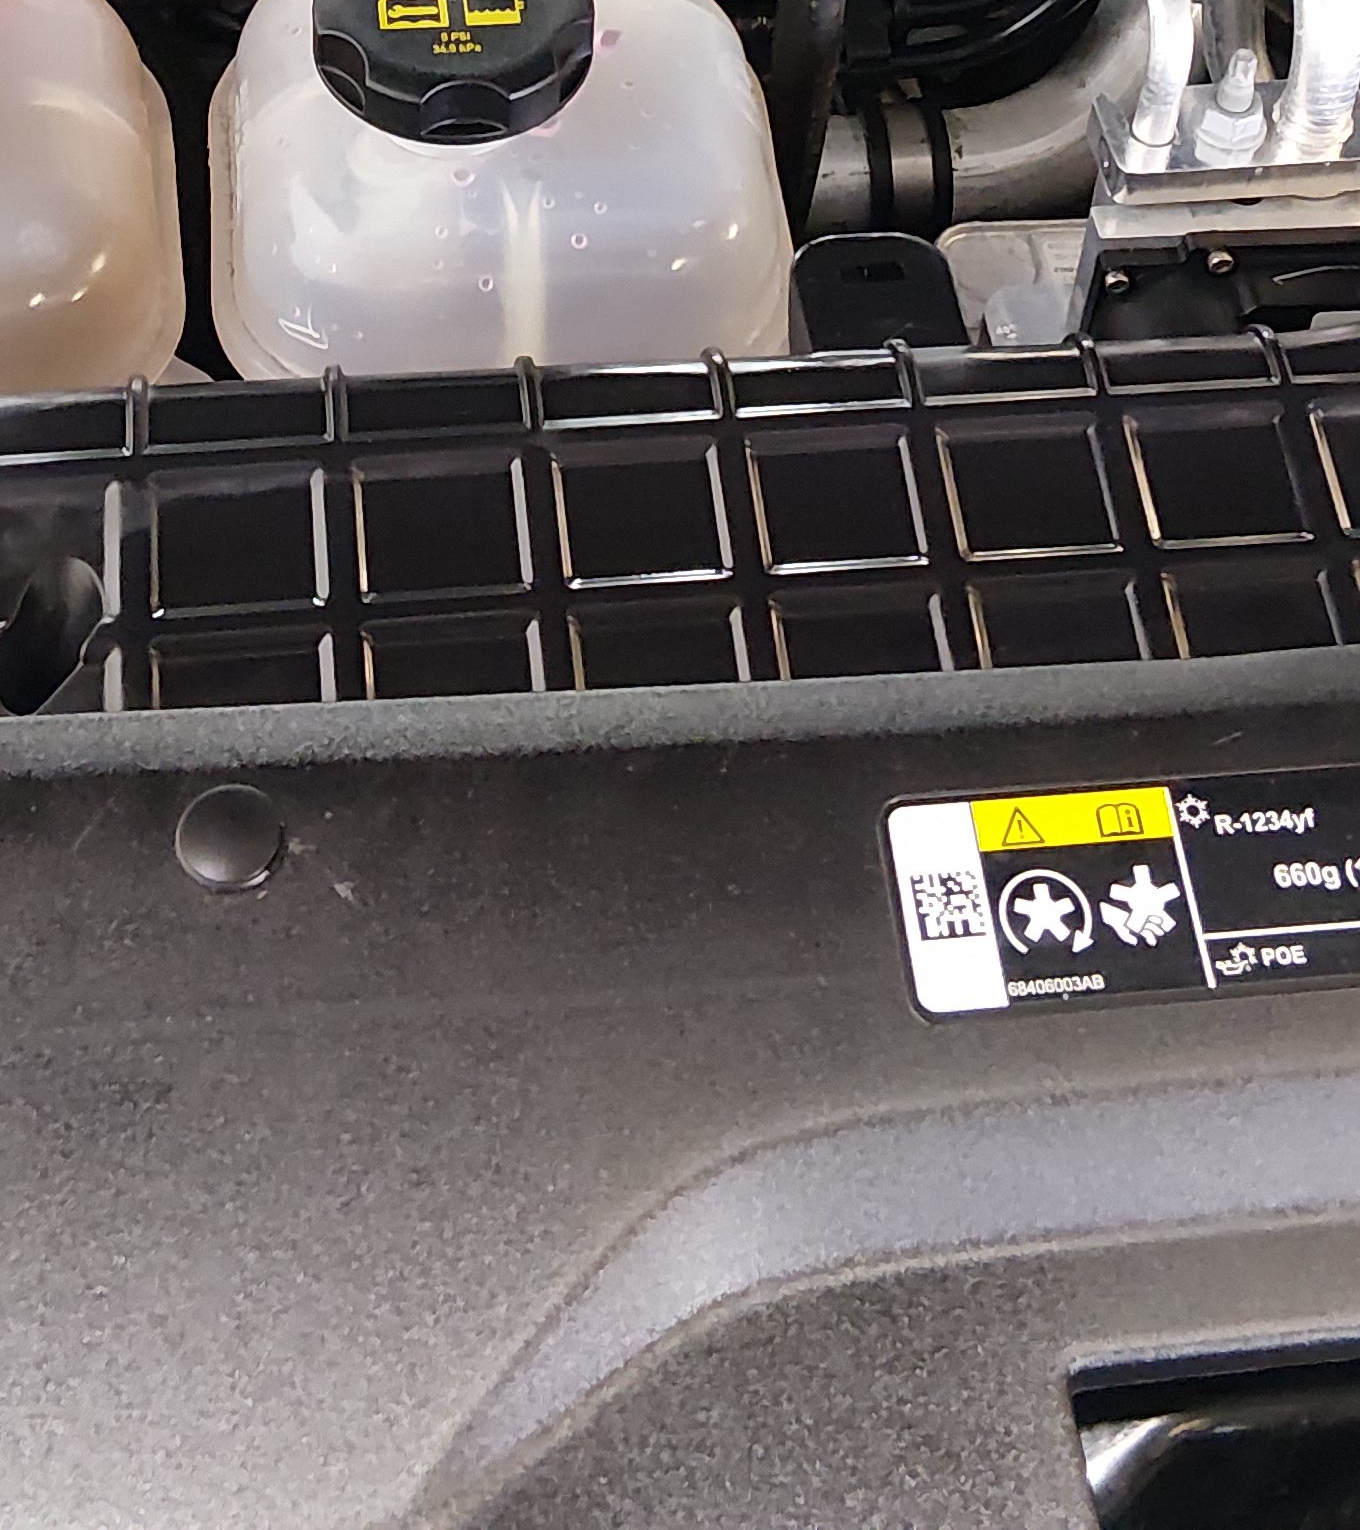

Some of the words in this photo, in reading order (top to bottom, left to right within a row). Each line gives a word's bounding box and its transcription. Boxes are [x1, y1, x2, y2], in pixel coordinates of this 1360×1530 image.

[1212, 807, 1316, 836] R-1234yf
[1273, 861, 1341, 891] 660g
[1261, 944, 1308, 967] POE
[1007, 973, 1106, 997] 68406003AB
